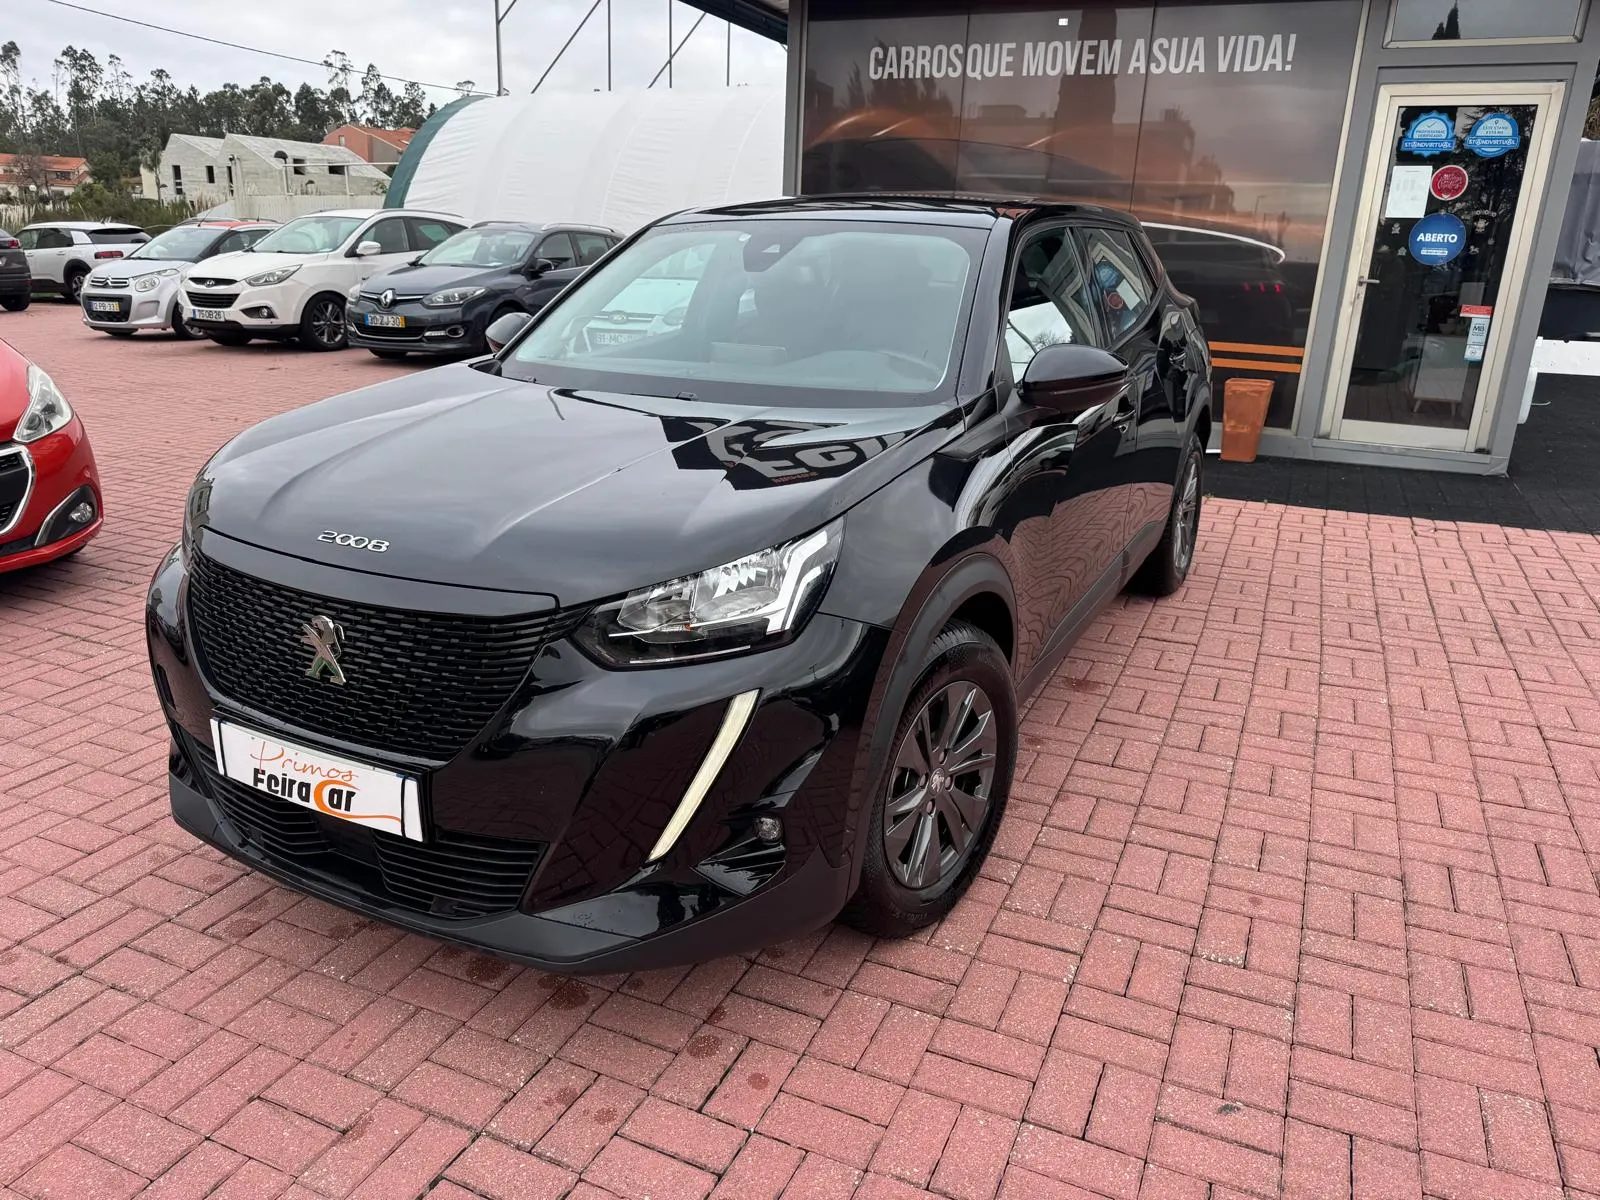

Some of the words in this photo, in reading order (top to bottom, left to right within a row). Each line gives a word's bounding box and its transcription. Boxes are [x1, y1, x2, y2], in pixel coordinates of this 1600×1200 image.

[869, 44, 963, 80] CARROS
[966, 42, 1017, 80] QUE
[1022, 39, 1123, 76] MOVEM
[1127, 38, 1146, 74] A
[1150, 37, 1205, 74] SUA
[1217, 33, 1297, 73] VIDA!
[1404, 141, 1452, 149] STANDVIRTUAL
[1416, 232, 1458, 243] ABERTO
[317, 530, 390, 552] 2008
